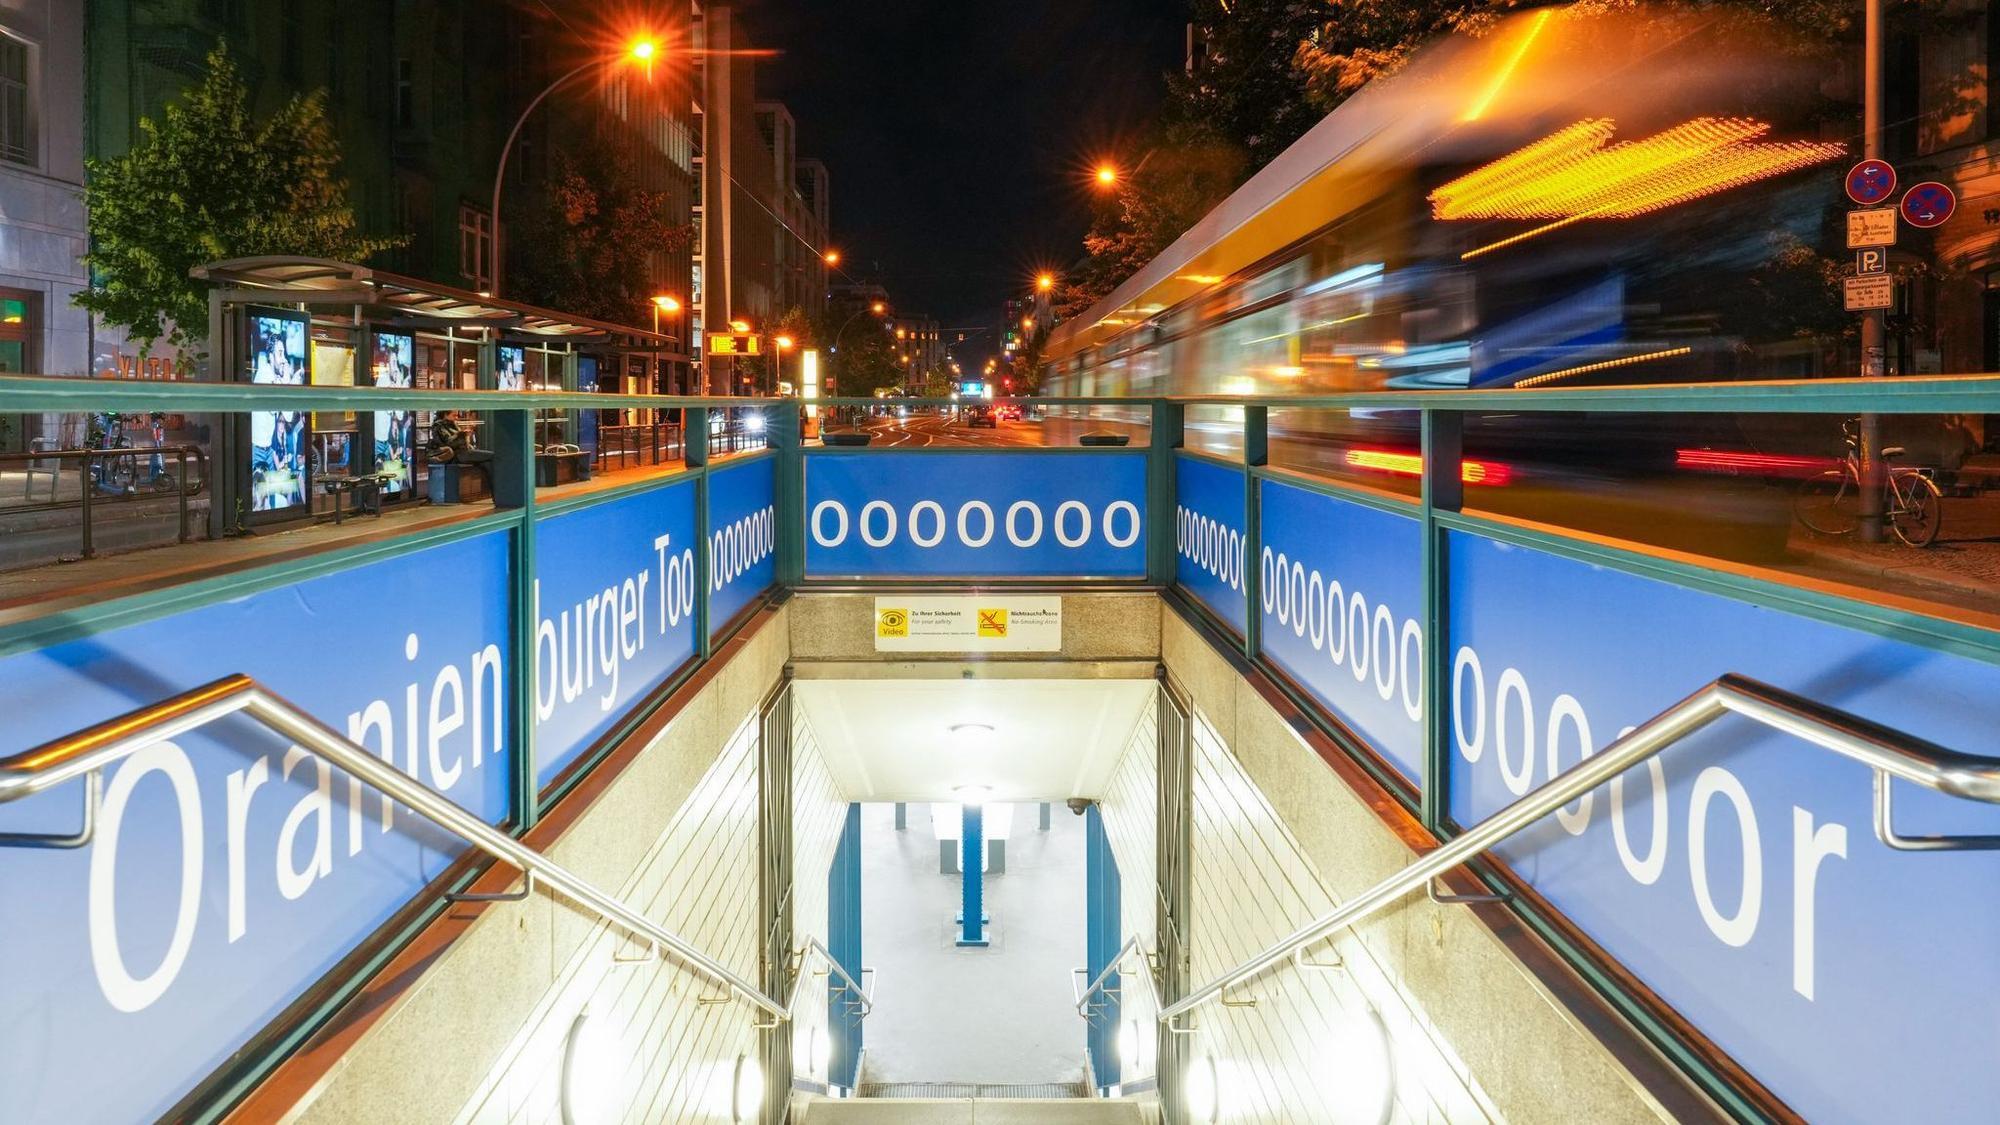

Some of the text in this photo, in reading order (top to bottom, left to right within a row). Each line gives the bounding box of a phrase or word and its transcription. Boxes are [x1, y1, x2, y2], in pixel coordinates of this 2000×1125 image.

[1863, 251, 1878, 271] P
[534, 533, 694, 725] burger Too
[89, 634, 502, 1012] Oranien
